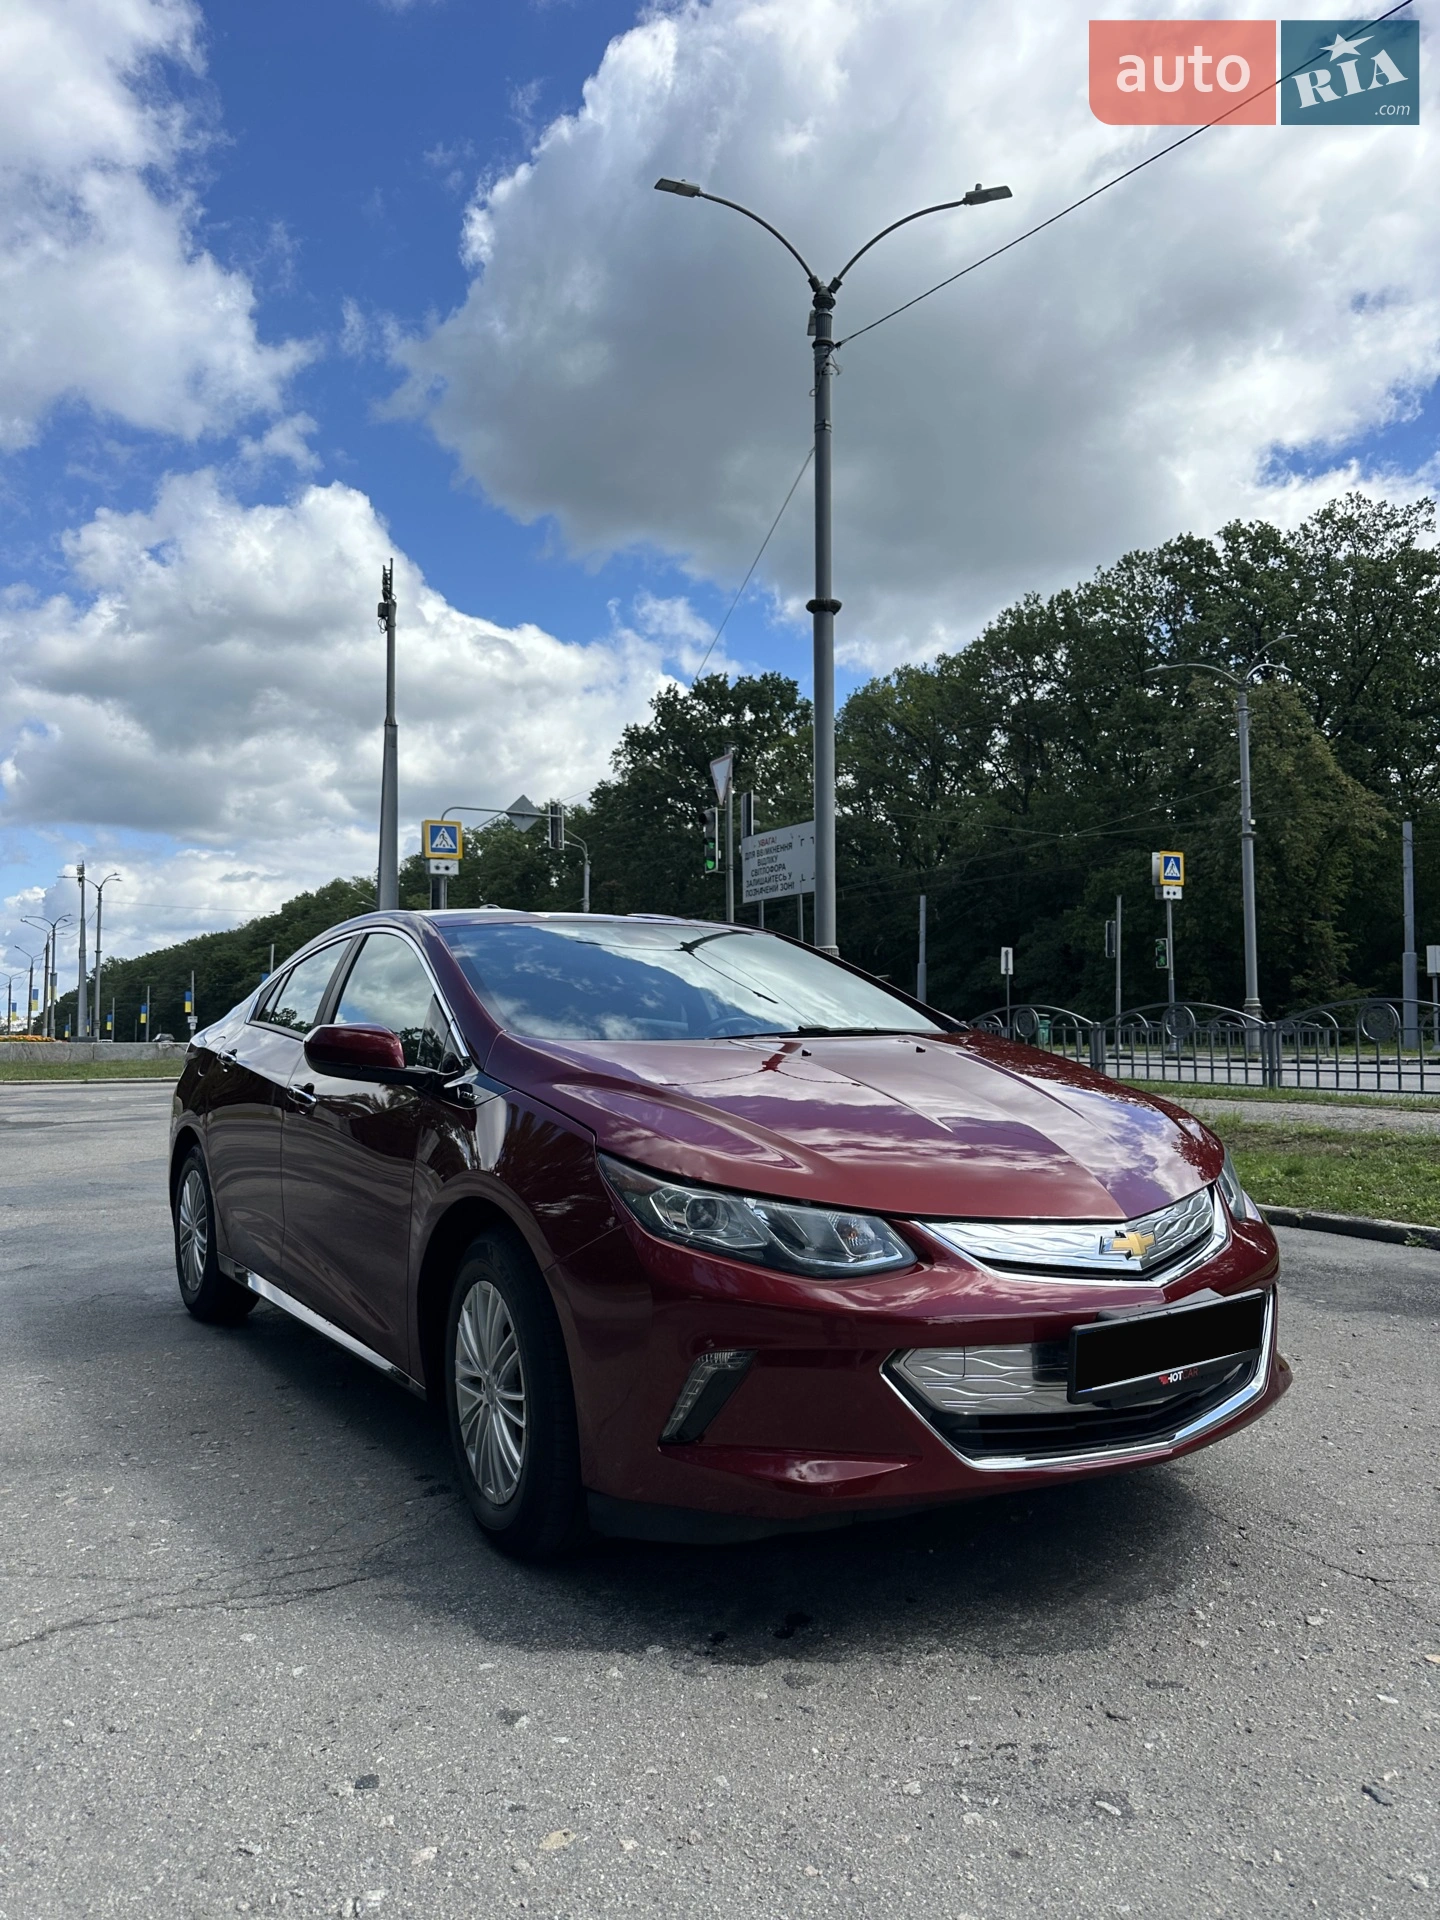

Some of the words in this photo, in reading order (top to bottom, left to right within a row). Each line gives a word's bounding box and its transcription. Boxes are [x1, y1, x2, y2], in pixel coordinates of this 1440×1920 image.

[758, 836, 777, 848] УВАГА!
[744, 850, 756, 861] ДЛЯ
[750, 863, 786, 878] СВІТЛОФОРА
